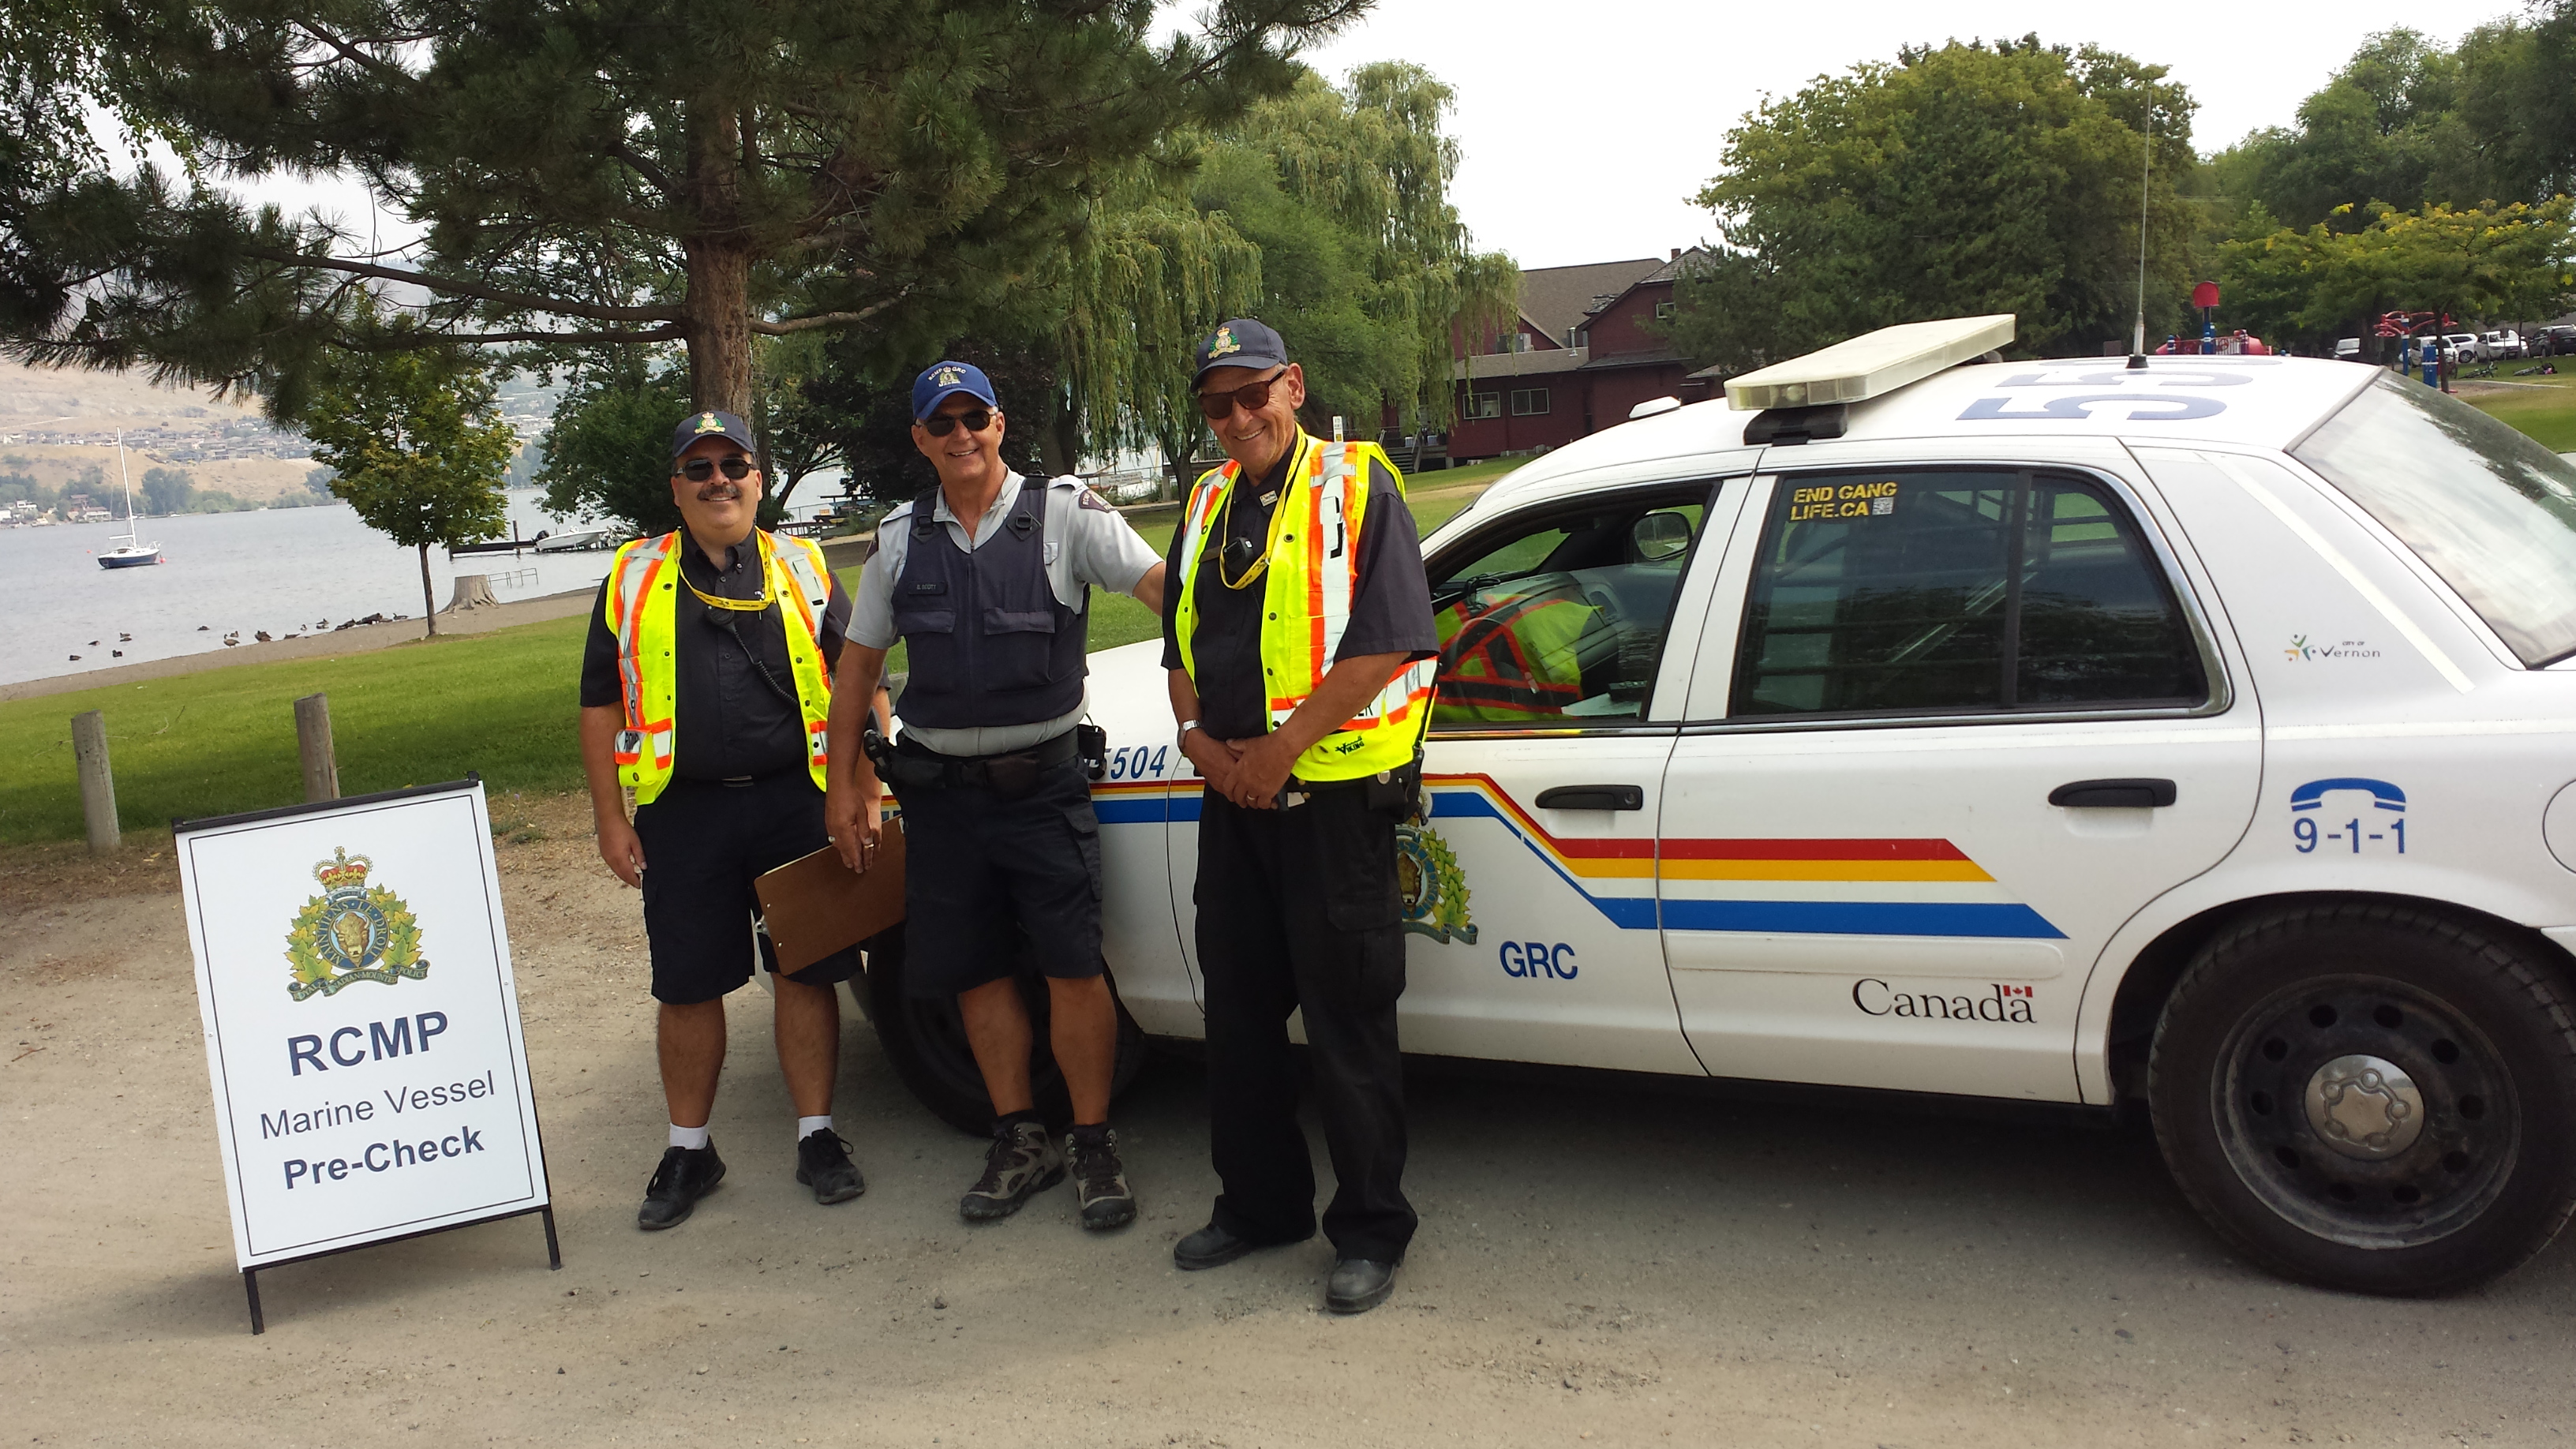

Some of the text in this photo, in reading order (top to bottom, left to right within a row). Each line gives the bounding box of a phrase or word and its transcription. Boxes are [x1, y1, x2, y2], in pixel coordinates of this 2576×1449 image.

[1790, 500, 1870, 521] LIFE.CA
[1792, 481, 1898, 504] END GANG
[2320, 645, 2381, 658] Vernon
[1338, 741, 1365, 755] VIKING
[2293, 817, 2405, 854] 9-1-1
[358, 900, 375, 916] LE
[373, 917, 388, 960] DROIT
[399, 966, 426, 978] POLICE
[1499, 940, 1578, 980] GRC
[1852, 978, 2038, 1024] Canada
[287, 1011, 448, 1076] RCMP
[260, 1069, 495, 1140] Marine Vessel
[283, 1125, 485, 1190] Pre-Check
